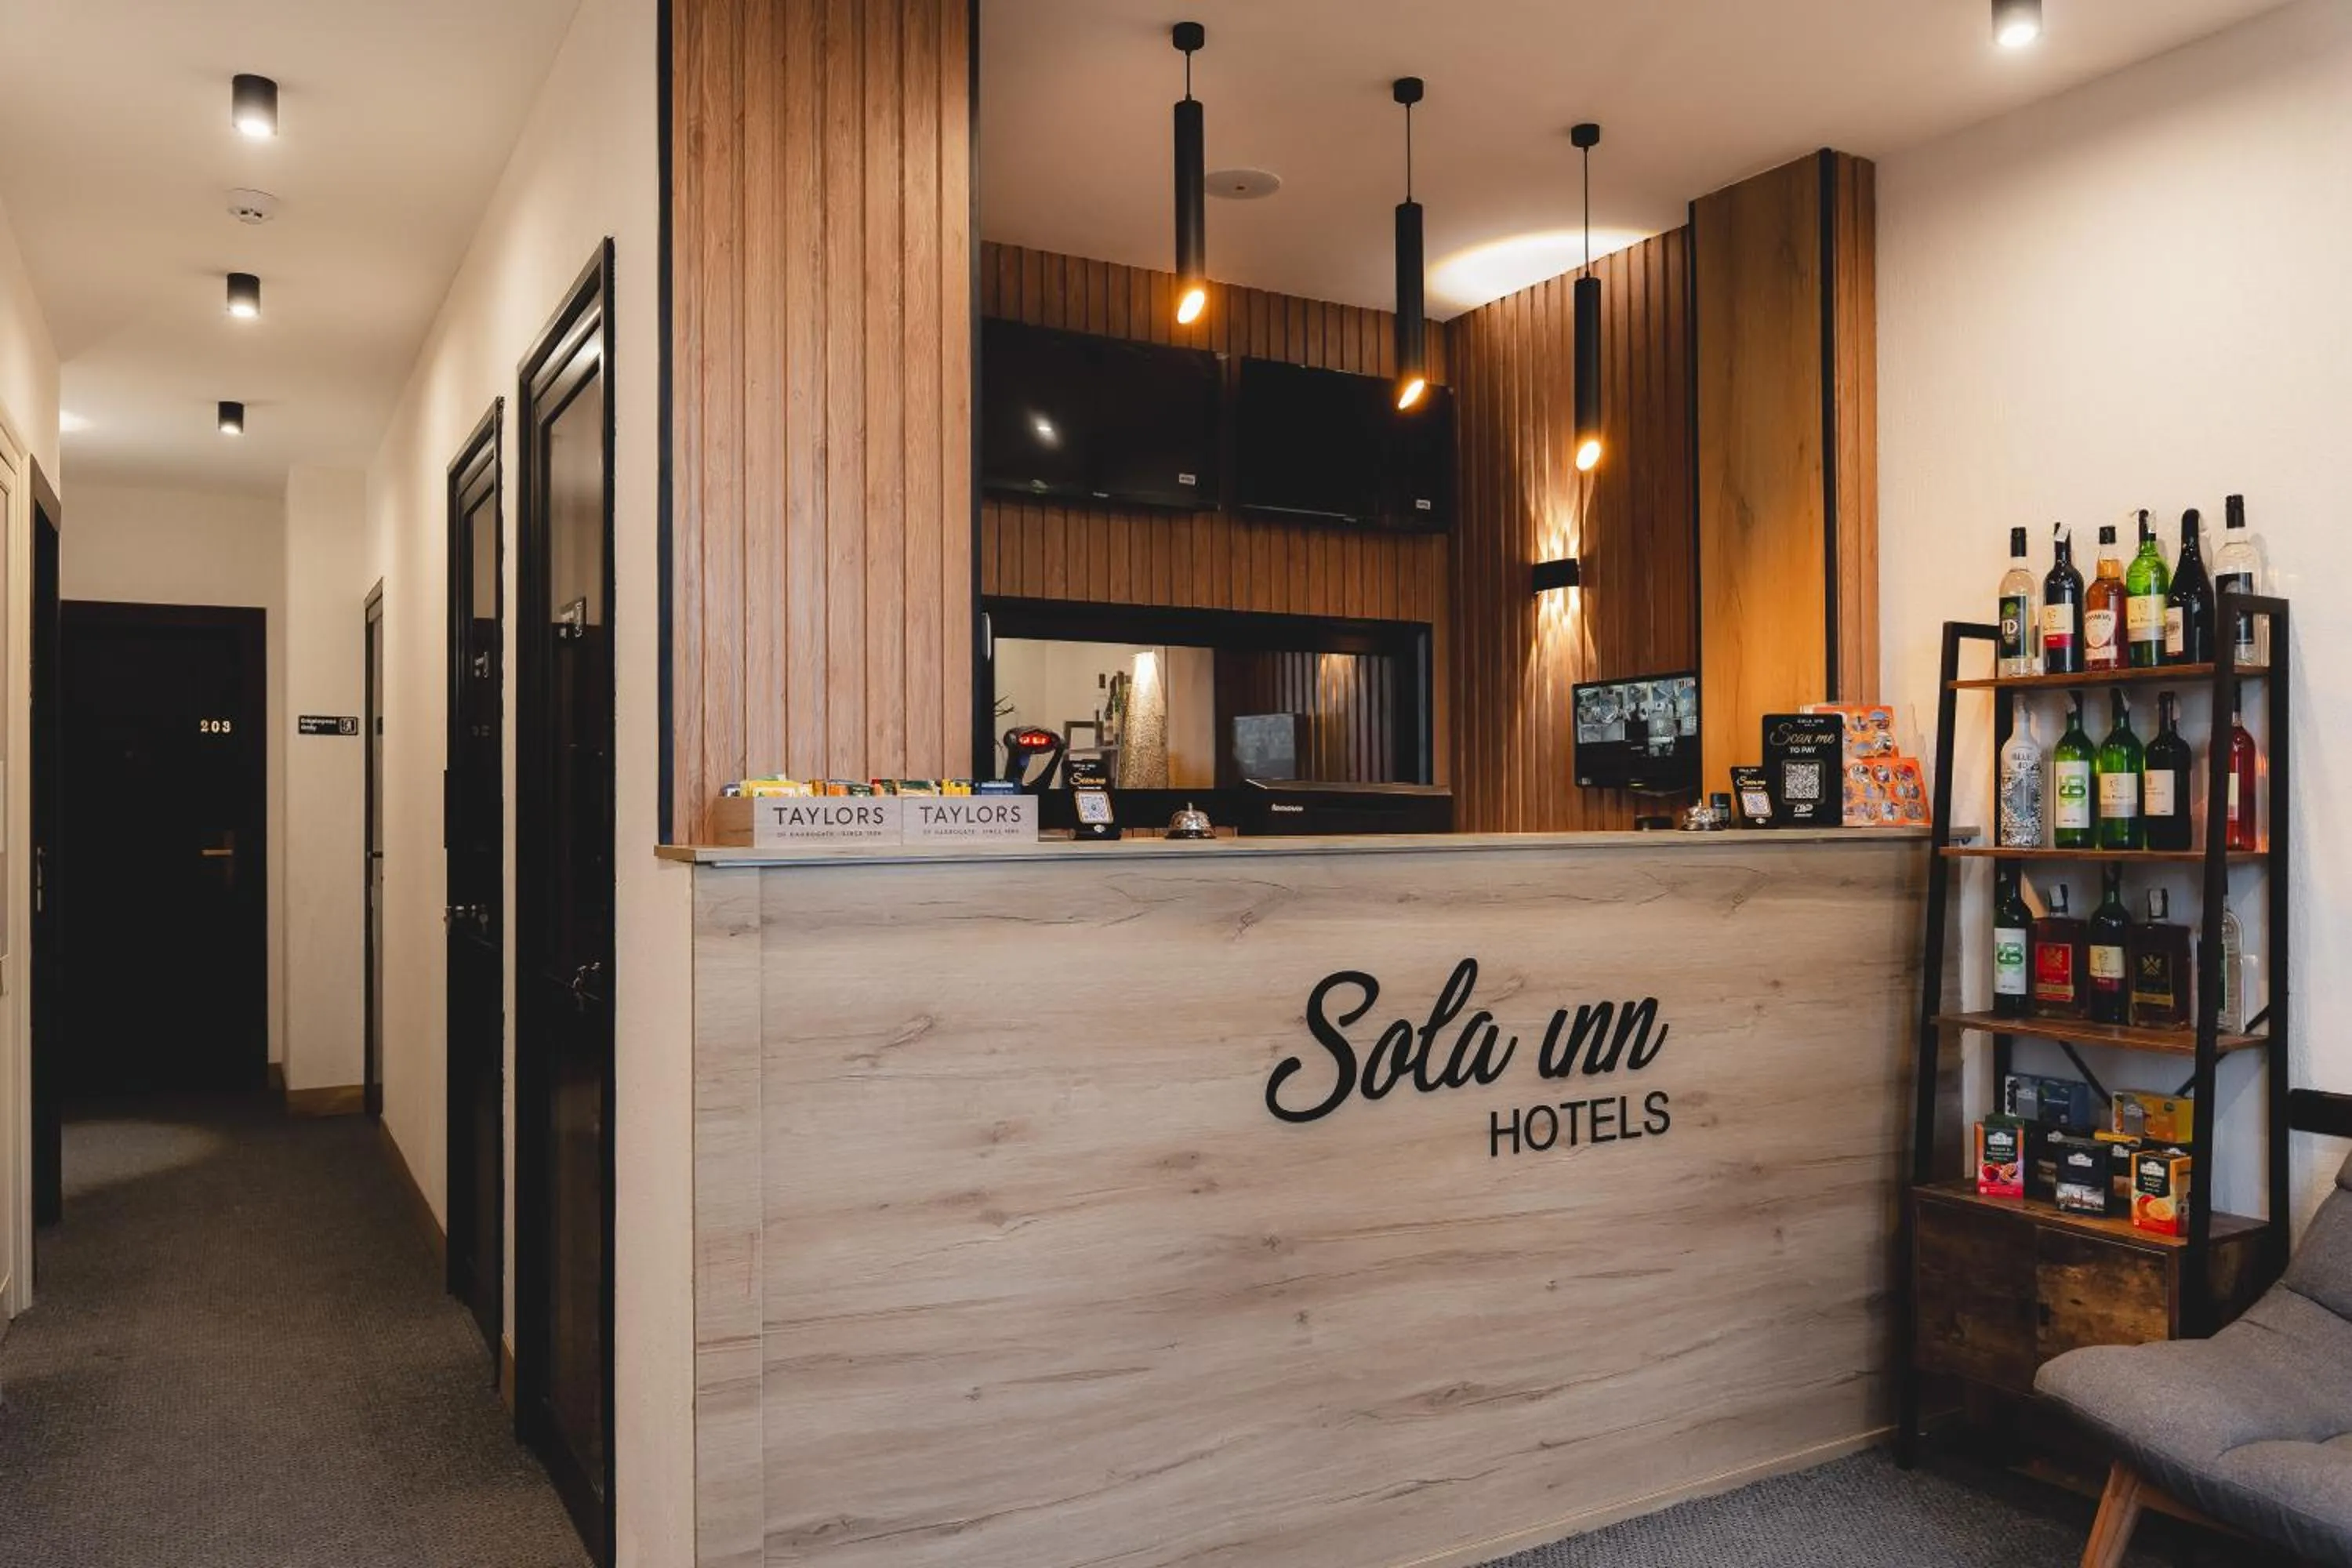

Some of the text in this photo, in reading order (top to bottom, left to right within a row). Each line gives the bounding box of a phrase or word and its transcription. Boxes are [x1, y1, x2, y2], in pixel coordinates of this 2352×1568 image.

[200, 720, 232, 733] 203
[1769, 722, 1835, 746] Scan me
[772, 807, 884, 826] TAYLORS
[919, 805, 1022, 824] TAYLORS
[1265, 957, 1669, 1123] Sola inn
[1490, 1091, 1671, 1157] HOTELS
